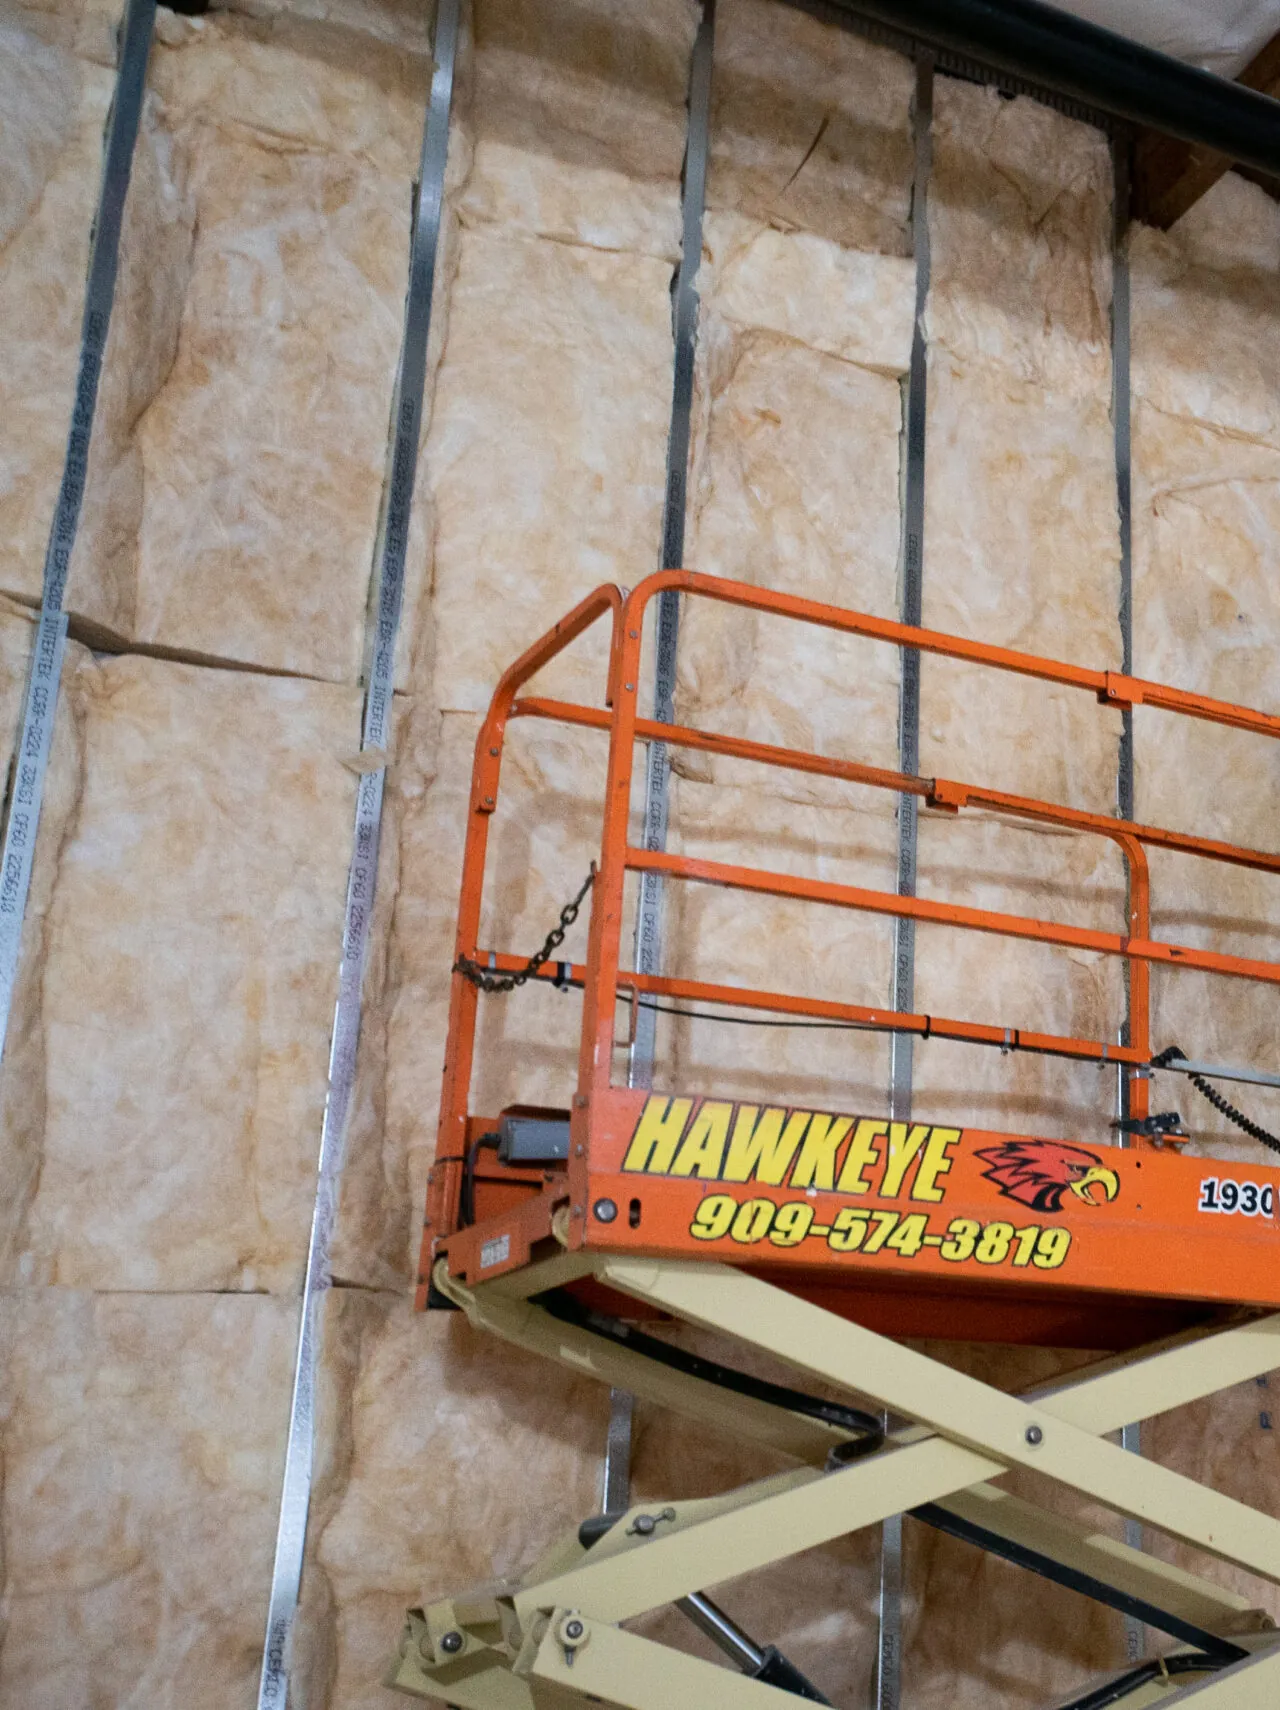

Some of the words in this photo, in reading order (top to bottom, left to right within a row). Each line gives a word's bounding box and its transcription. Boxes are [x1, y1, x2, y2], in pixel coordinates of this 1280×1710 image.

[34, 615, 60, 681] INTERTEK
[368, 685, 386, 744] INTERTEK
[620, 1095, 962, 1204] HAWKEYE
[690, 1195, 1071, 1270] 909-574-3819
